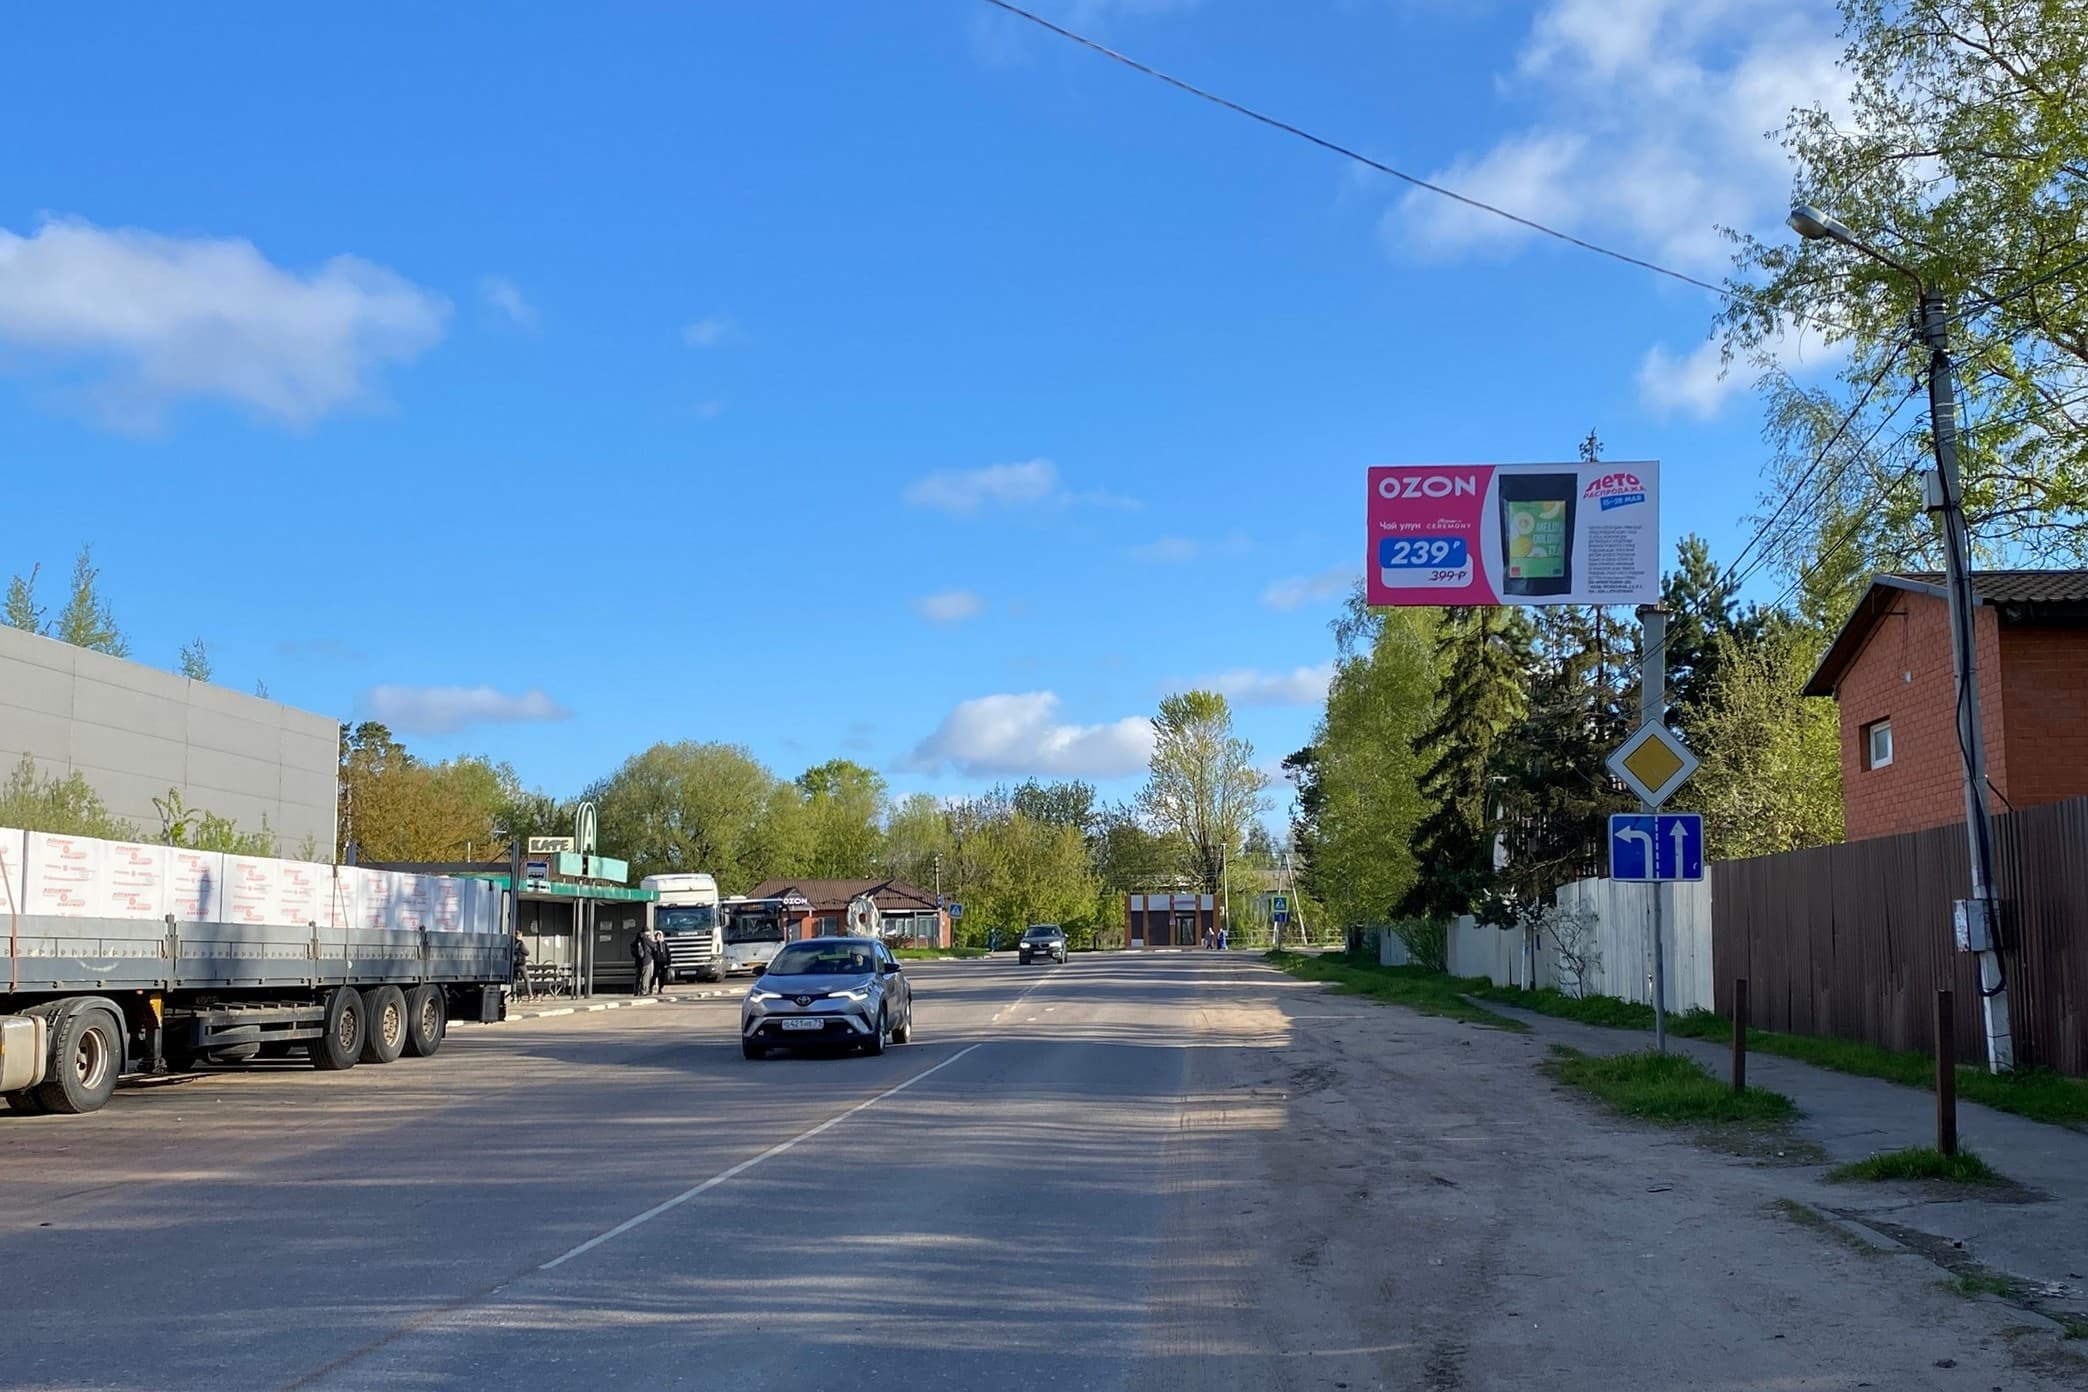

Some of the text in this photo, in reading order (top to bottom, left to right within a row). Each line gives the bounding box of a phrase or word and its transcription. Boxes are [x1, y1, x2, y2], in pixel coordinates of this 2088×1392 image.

[1379, 475, 1476, 499] OZON
[1379, 518, 1421, 532] Чай улун
[1426, 522, 1472, 530] CEREMONY
[1390, 540, 1450, 565] 239
[1430, 570, 1455, 582] 399
[530, 839, 569, 852] КАФЕ
[783, 896, 808, 905] OZON
